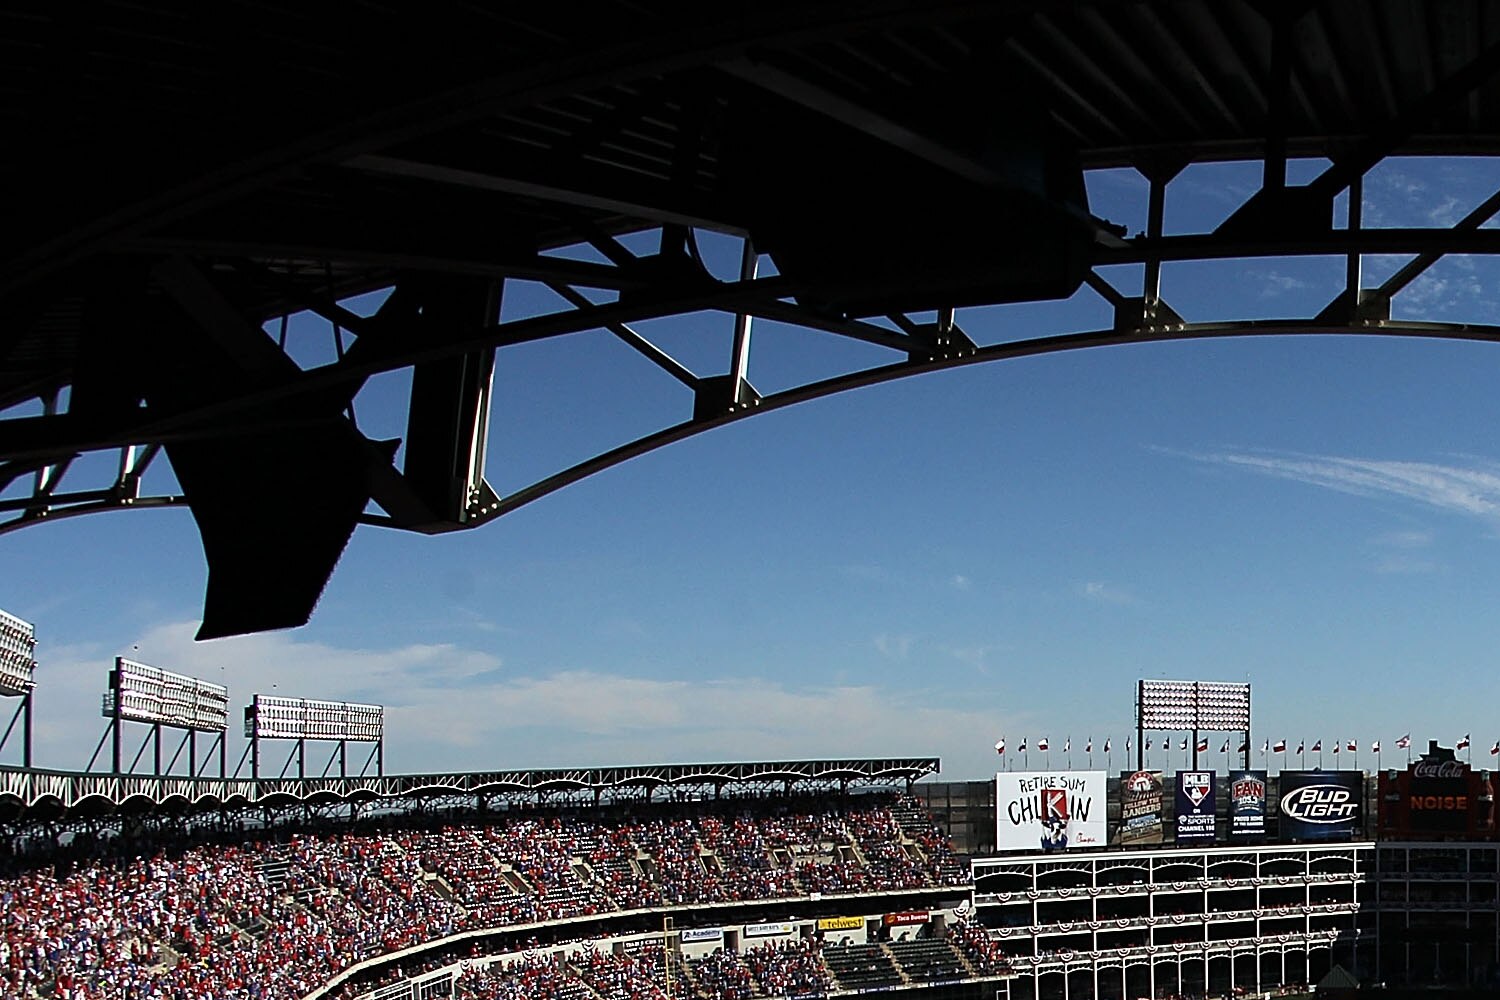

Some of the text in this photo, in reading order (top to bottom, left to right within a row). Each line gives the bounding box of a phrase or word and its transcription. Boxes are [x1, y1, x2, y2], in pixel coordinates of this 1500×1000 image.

[1019, 776, 1086, 793] RETIRE SUM
[1184, 775, 1209, 785] MLB
[1232, 782, 1264, 798] FAN
[1299, 789, 1350, 803] BUD
[1290, 804, 1358, 817] LIGHT
[1410, 795, 1469, 811] NOISE
[1122, 803, 1161, 819] RANGERS
[692, 930, 721, 938] Academy
